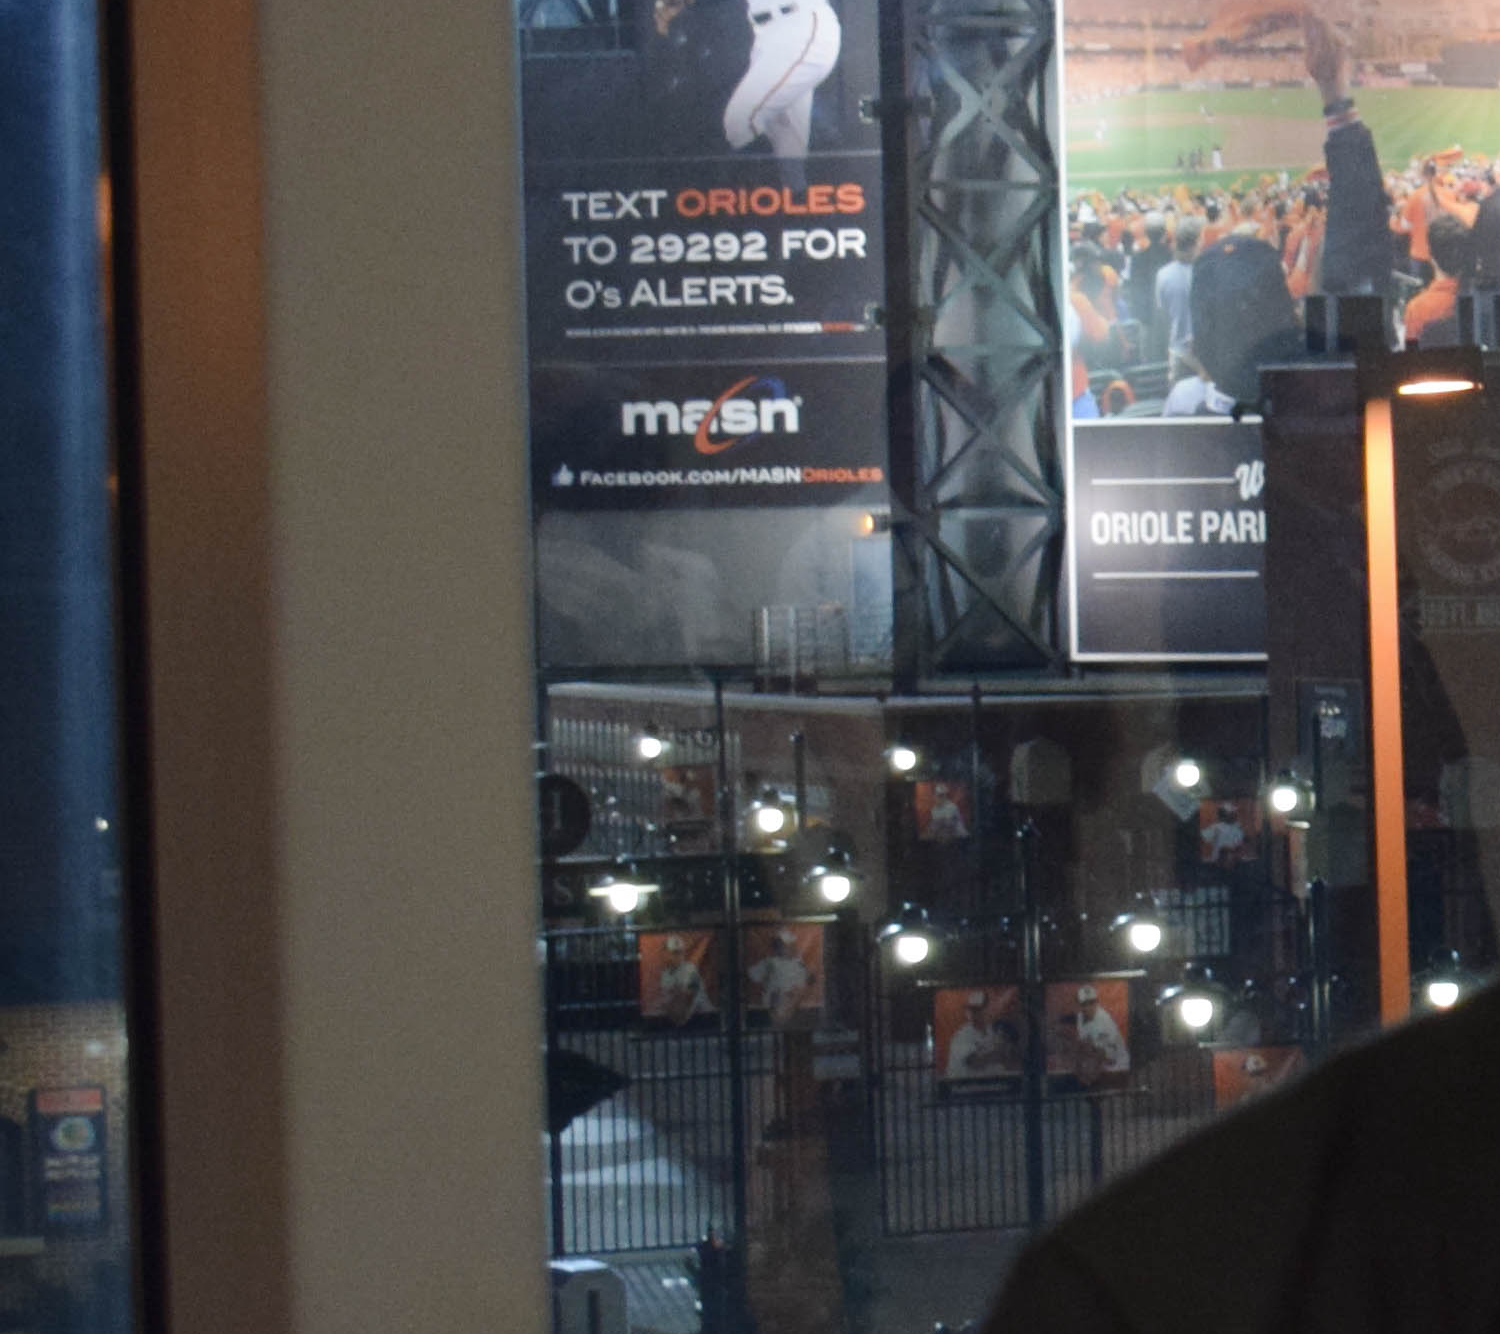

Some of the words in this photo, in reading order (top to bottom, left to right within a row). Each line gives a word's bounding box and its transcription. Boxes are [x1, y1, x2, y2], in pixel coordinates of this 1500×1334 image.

[562, 189, 667, 221] TEXT
[675, 182, 866, 217] ORIOLES
[563, 234, 617, 265] TO
[630, 230, 768, 264] 29292
[782, 227, 867, 260] FOR
[565, 279, 622, 310] O's
[630, 273, 794, 308] ALERTS.
[621, 396, 799, 436] masn
[1090, 510, 1195, 546] ORIOLE
